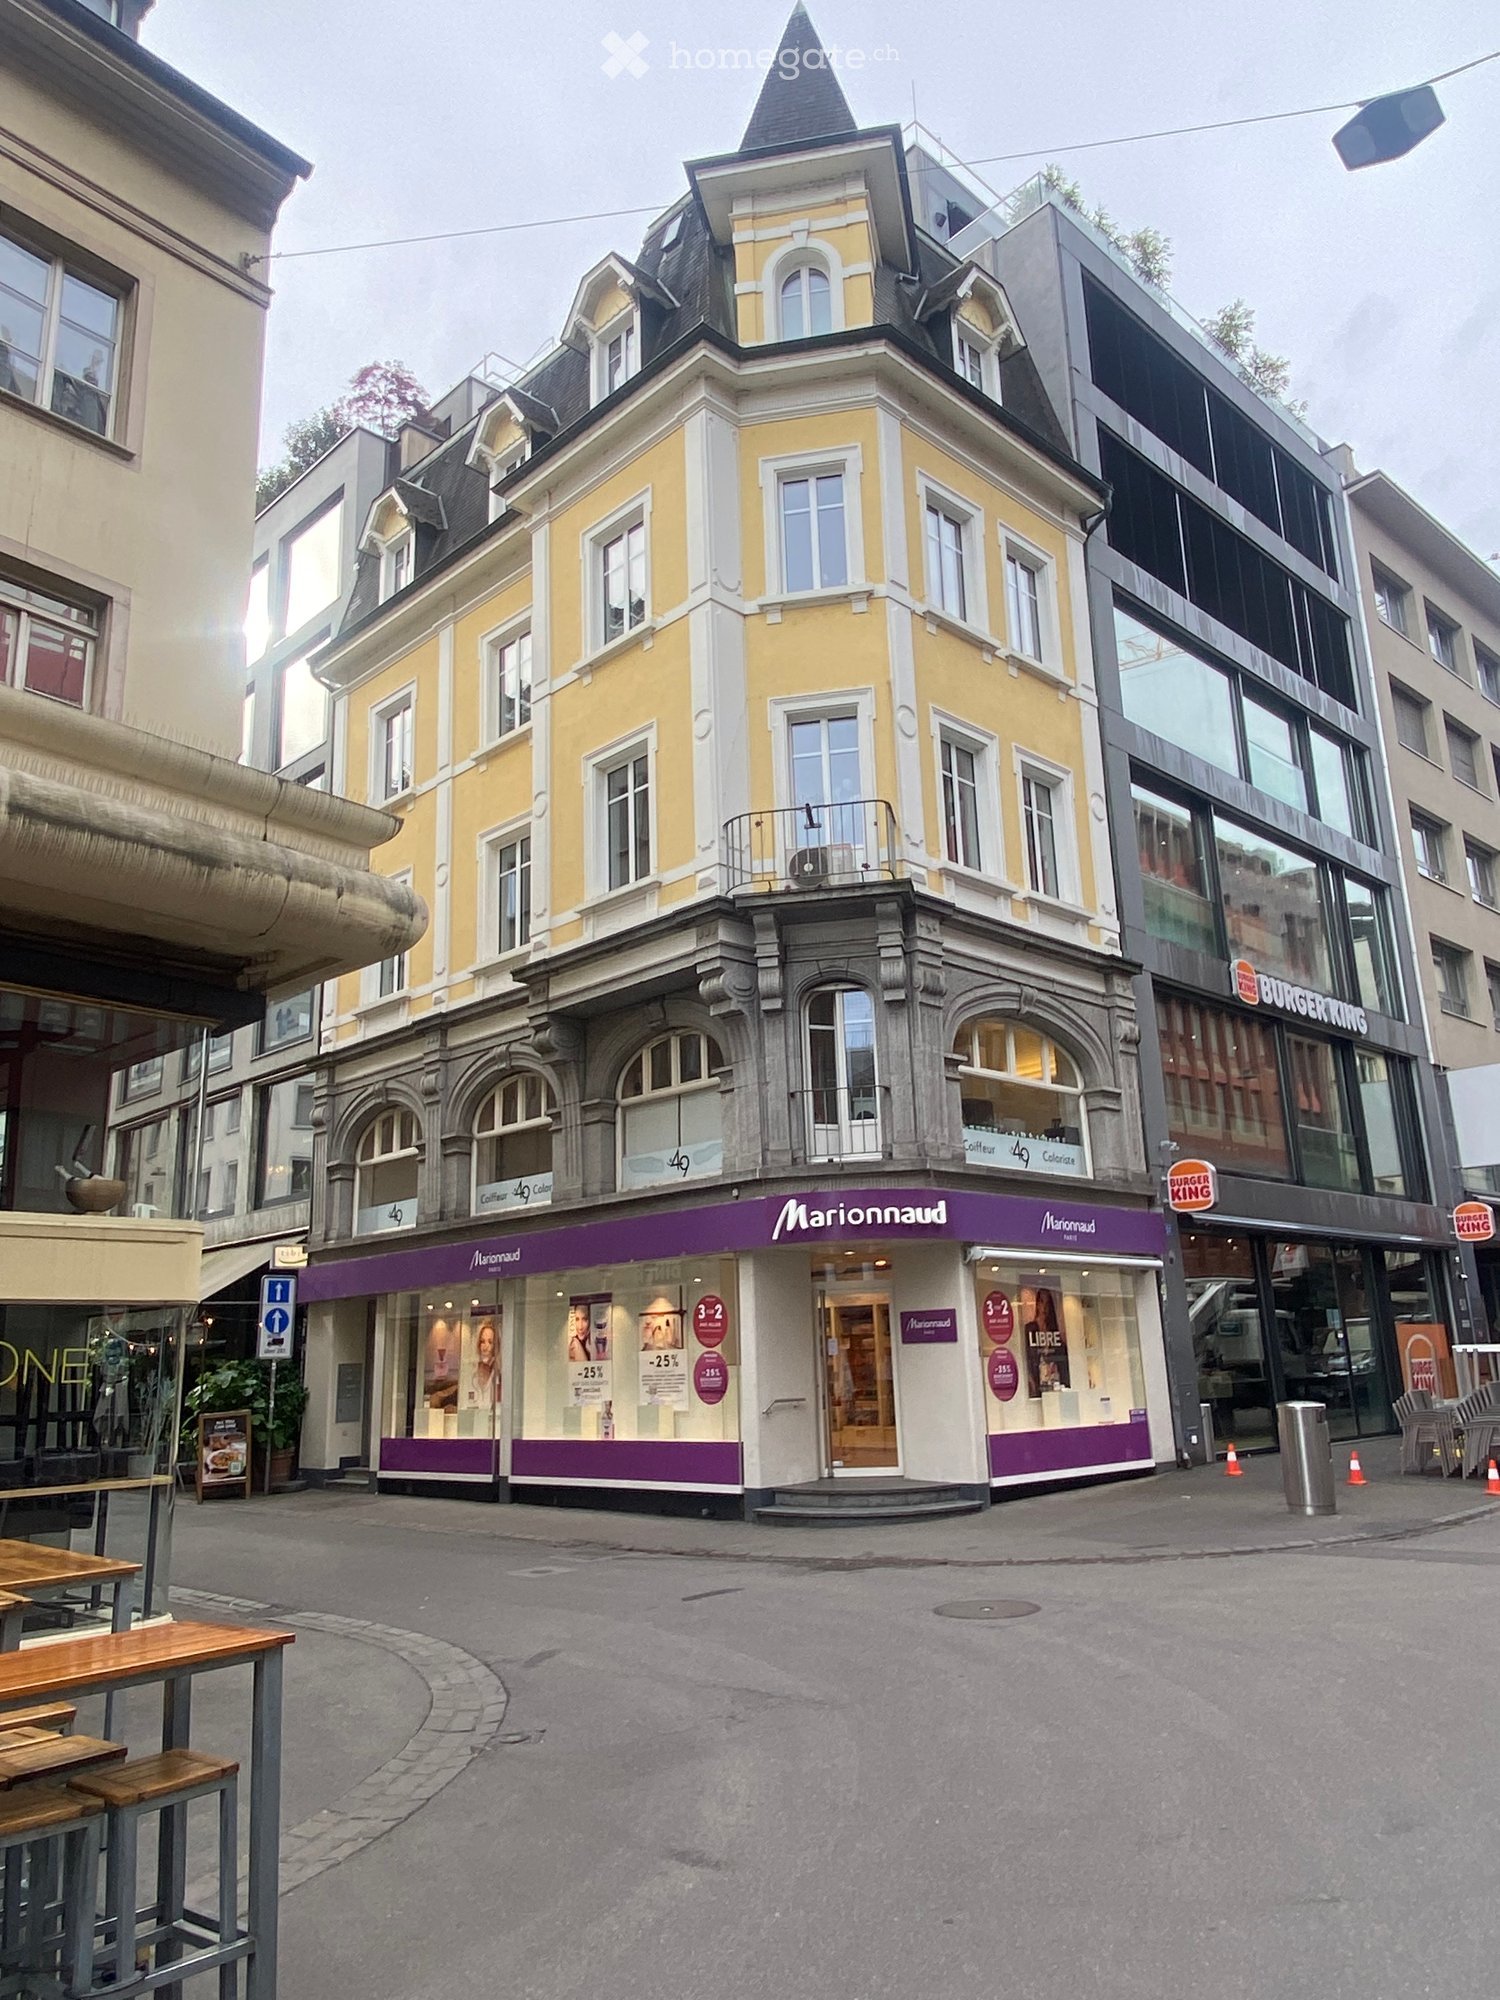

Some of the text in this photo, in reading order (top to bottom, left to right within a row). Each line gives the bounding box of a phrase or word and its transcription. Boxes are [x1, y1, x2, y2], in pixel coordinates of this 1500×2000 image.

[1238, 982, 1257, 996] KING
[1260, 974, 1368, 1035] BURGER KING
[963, 1140, 996, 1155] Coiffeur
[1042, 1150, 1076, 1165] Coloriste
[1170, 1175, 1210, 1187] BURGER
[1171, 1185, 1211, 1201] KING
[772, 1198, 947, 1240] Marionnaud
[1041, 1211, 1096, 1233] Marionnaud
[1456, 1213, 1489, 1223] BURGER
[1457, 1221, 1490, 1232] KING
[469, 1248, 520, 1270] Marionnaud
[698, 1304, 723, 1319] 3 2
[986, 1299, 1009, 1316] 3 2
[906, 1317, 951, 1331] Marionnaud
[1028, 1331, 1062, 1347] LIBRE
[648, 1354, 679, 1368] -25%
[577, 1366, 604, 1379] -25%
